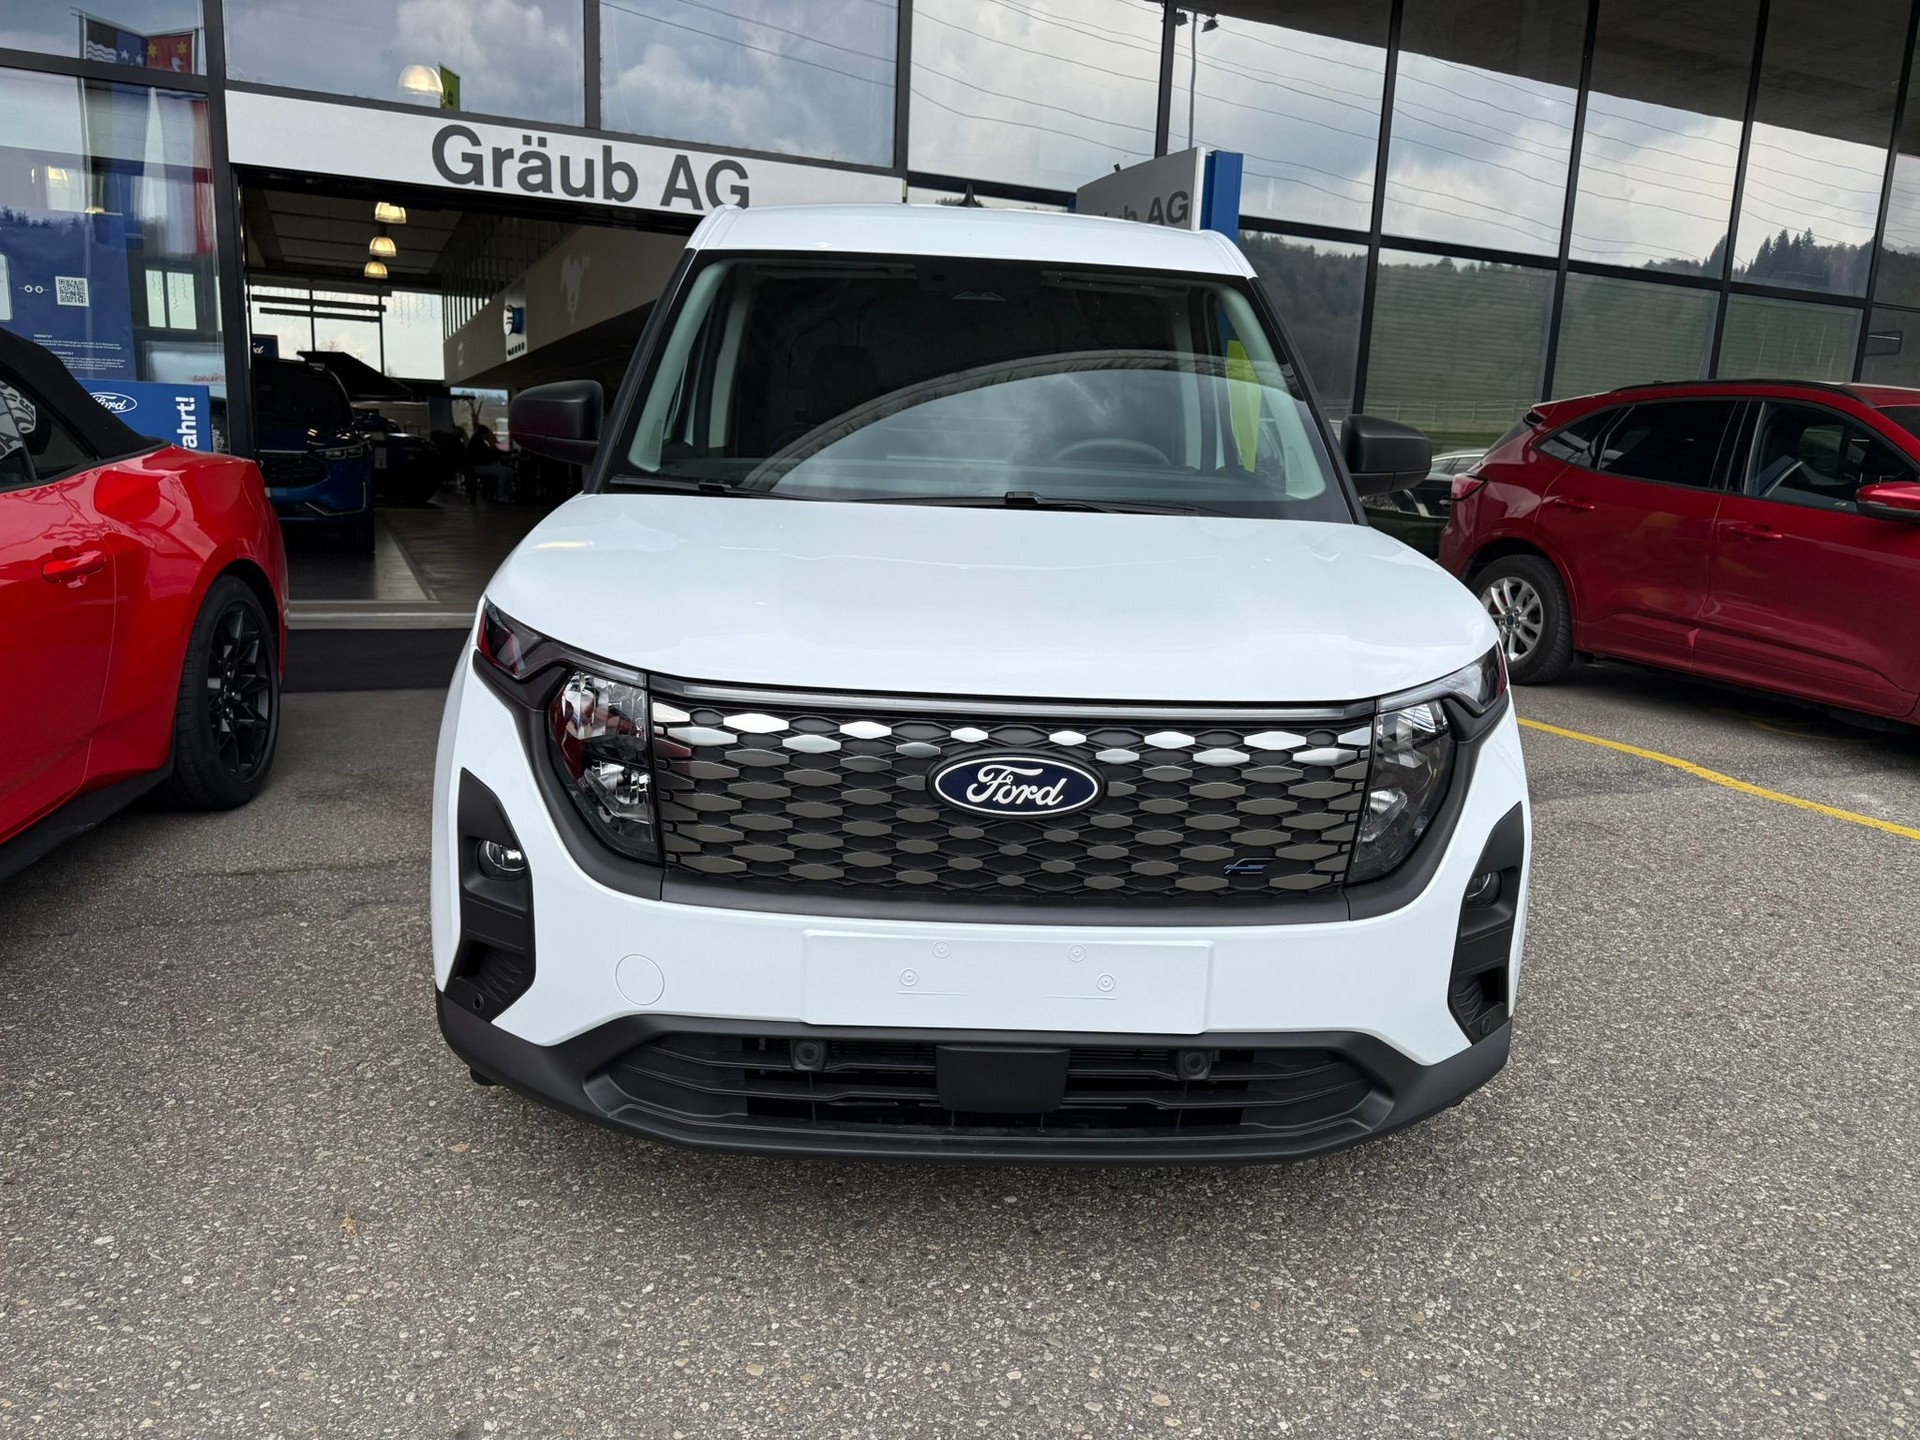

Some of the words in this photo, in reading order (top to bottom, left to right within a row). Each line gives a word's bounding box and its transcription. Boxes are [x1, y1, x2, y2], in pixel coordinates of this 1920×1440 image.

[432, 124, 639, 203] Gräub
[660, 154, 750, 211] AG
[1147, 190, 1189, 226] AG
[175, 396, 198, 450] ahrt!
[966, 764, 1068, 806] Ford
